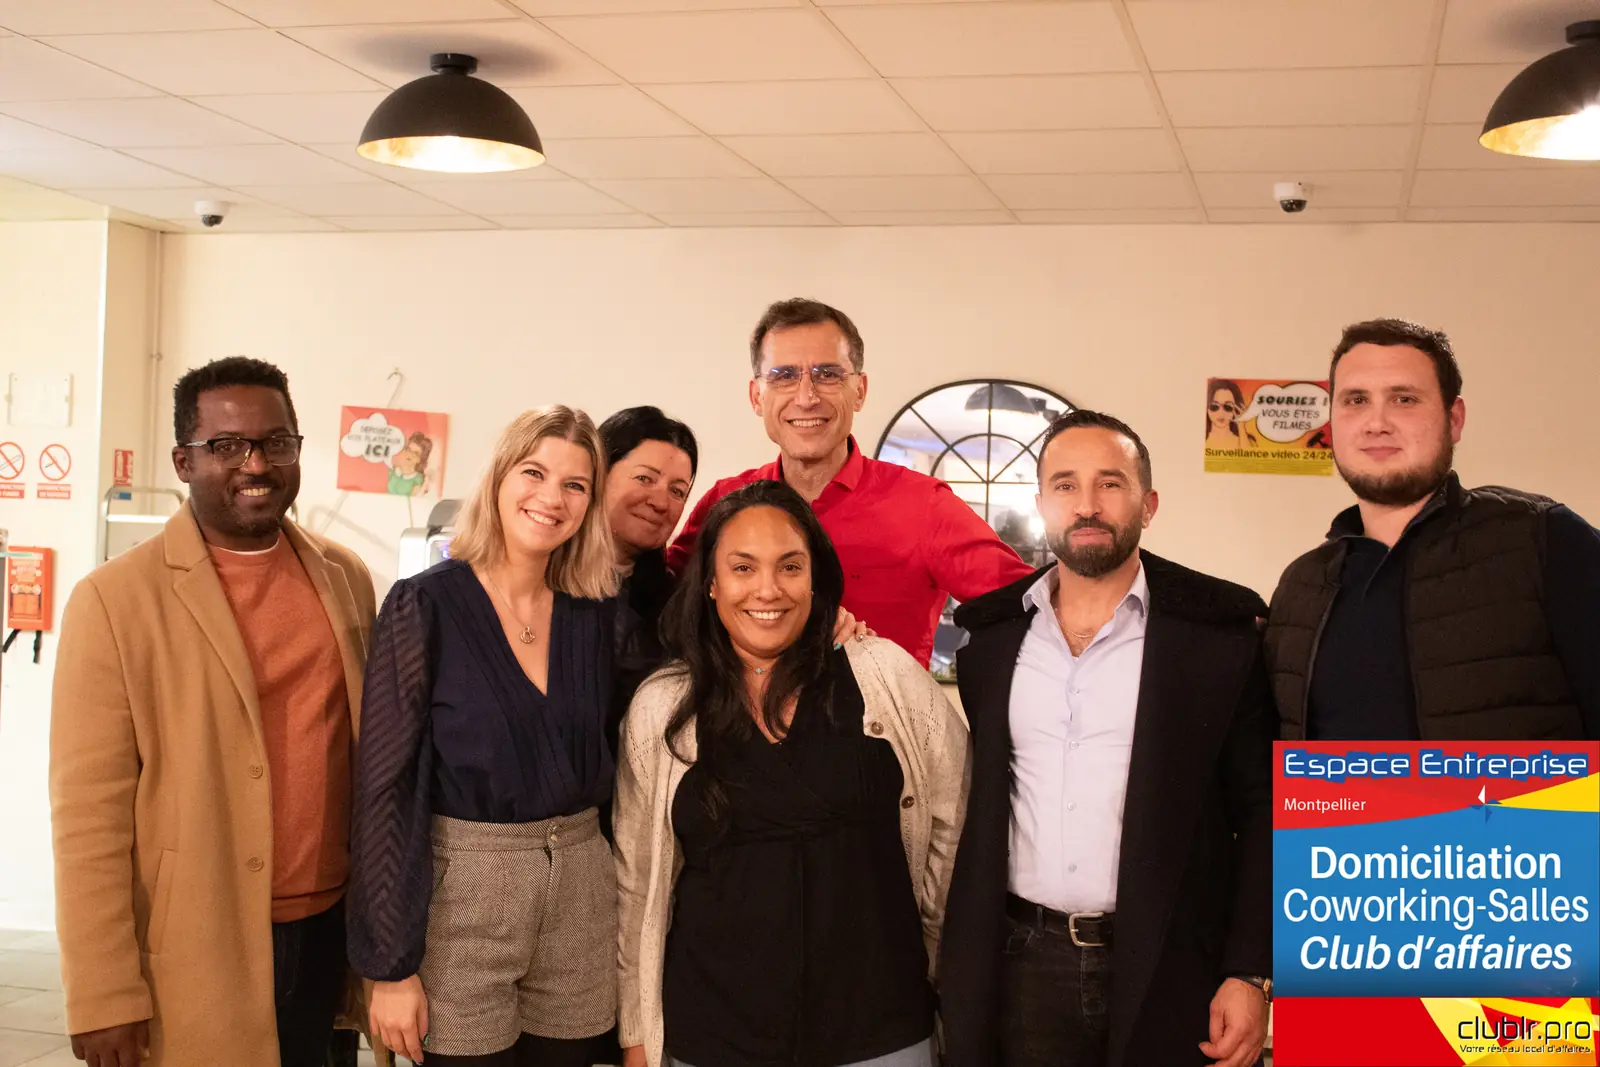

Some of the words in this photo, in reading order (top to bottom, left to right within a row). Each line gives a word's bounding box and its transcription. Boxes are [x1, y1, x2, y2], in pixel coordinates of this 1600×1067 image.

[1257, 395, 1316, 406] SOURIEZ
[1261, 408, 1290, 418] VOUS
[365, 444, 390, 457] ICI
[1204, 447, 1269, 459] Surveillance
[1303, 450, 1334, 460] 24/24
